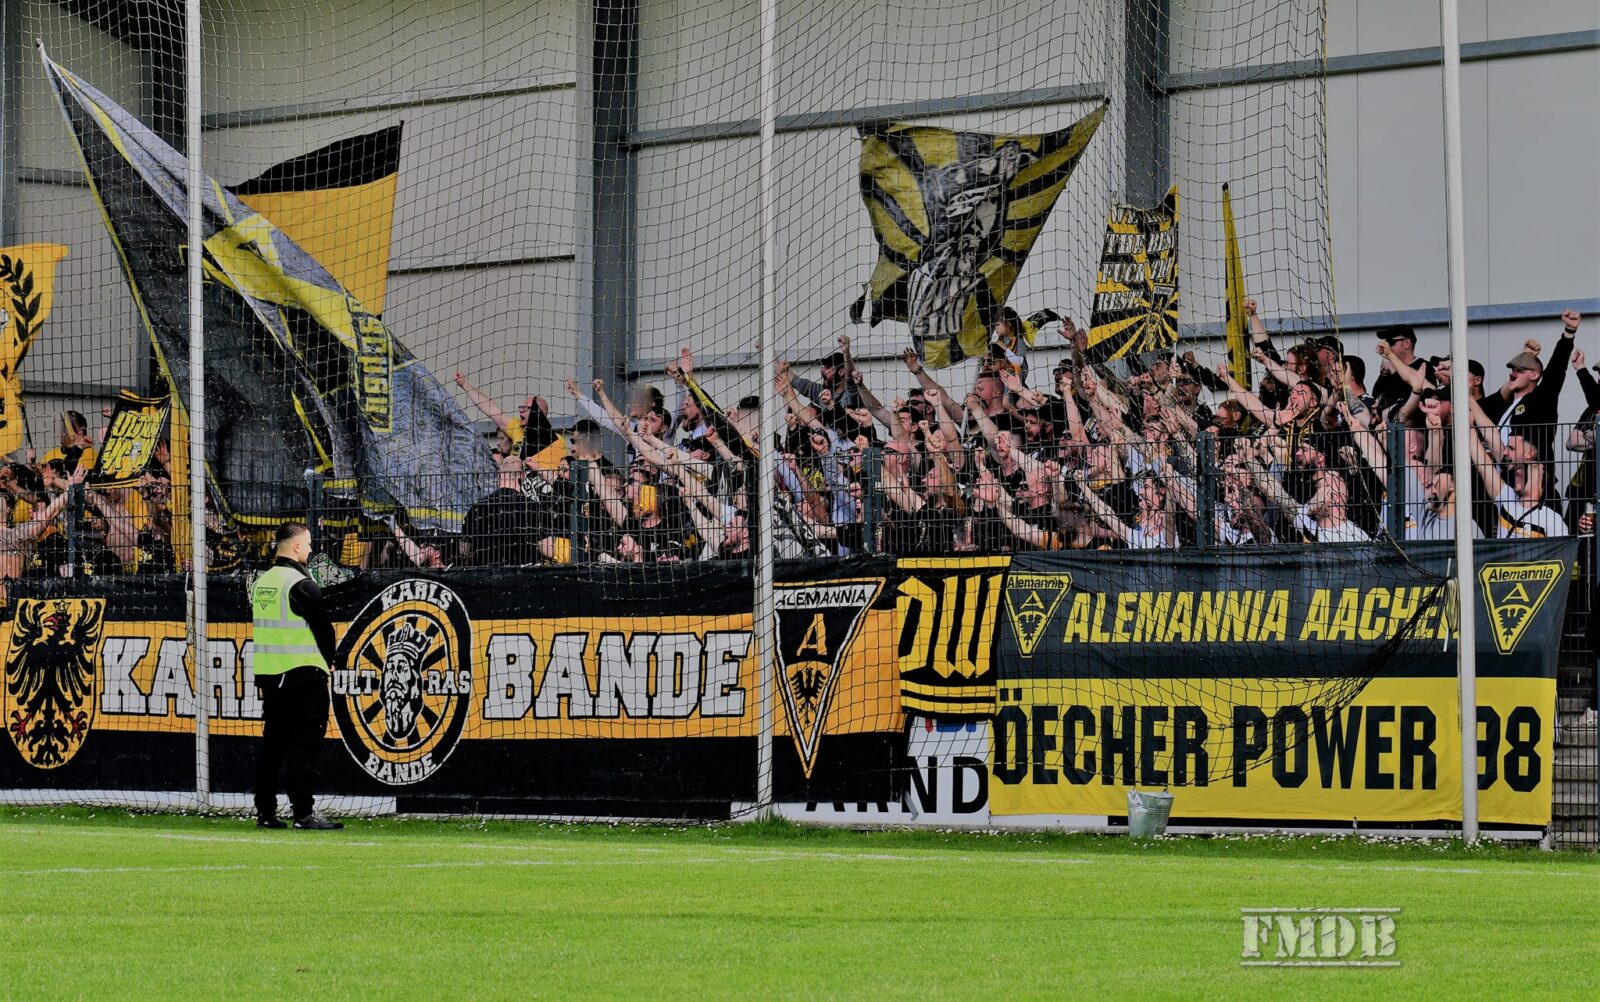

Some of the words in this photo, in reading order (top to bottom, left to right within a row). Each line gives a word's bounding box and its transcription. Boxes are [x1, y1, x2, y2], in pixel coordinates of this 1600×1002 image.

[1007, 576, 1064, 588] Alemannia
[1488, 566, 1554, 582] Alemannia
[381, 581, 453, 611] KARLS
[775, 588, 868, 606] ALEMANNIA
[1020, 591, 1045, 610] A
[1502, 583, 1531, 603] A
[1063, 590, 1290, 644] ALEMANNIA
[796, 613, 828, 657] A
[100, 636, 264, 719] KARL
[483, 630, 752, 720] BANDE
[333, 669, 376, 695] ULT
[427, 669, 471, 696] RAS
[992, 687, 1208, 787] ÖECHER
[1233, 705, 1437, 790] POWER
[1476, 706, 1541, 792] 98
[364, 752, 437, 783] BANDE
